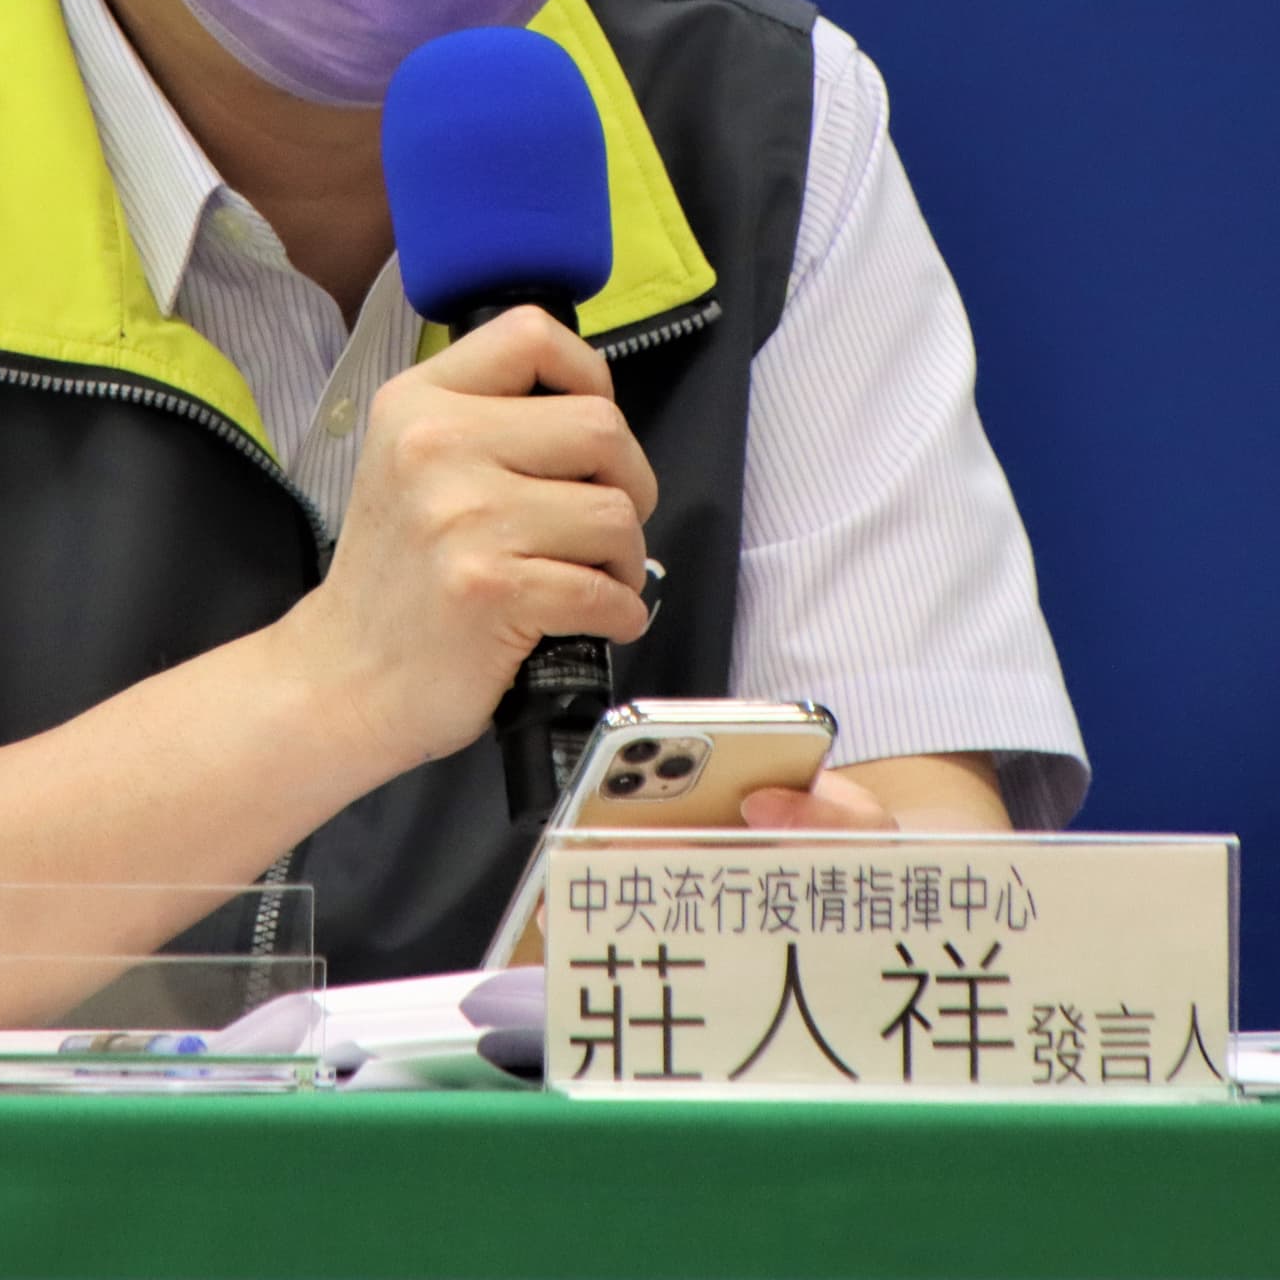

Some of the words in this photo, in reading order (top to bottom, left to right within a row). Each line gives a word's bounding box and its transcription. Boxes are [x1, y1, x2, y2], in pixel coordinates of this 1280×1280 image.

[568, 865, 1037, 934] 中央流行疫情指揮中心
[569, 942, 1014, 1082] 莊人祥
[1028, 1003, 1224, 1084] 發言人
